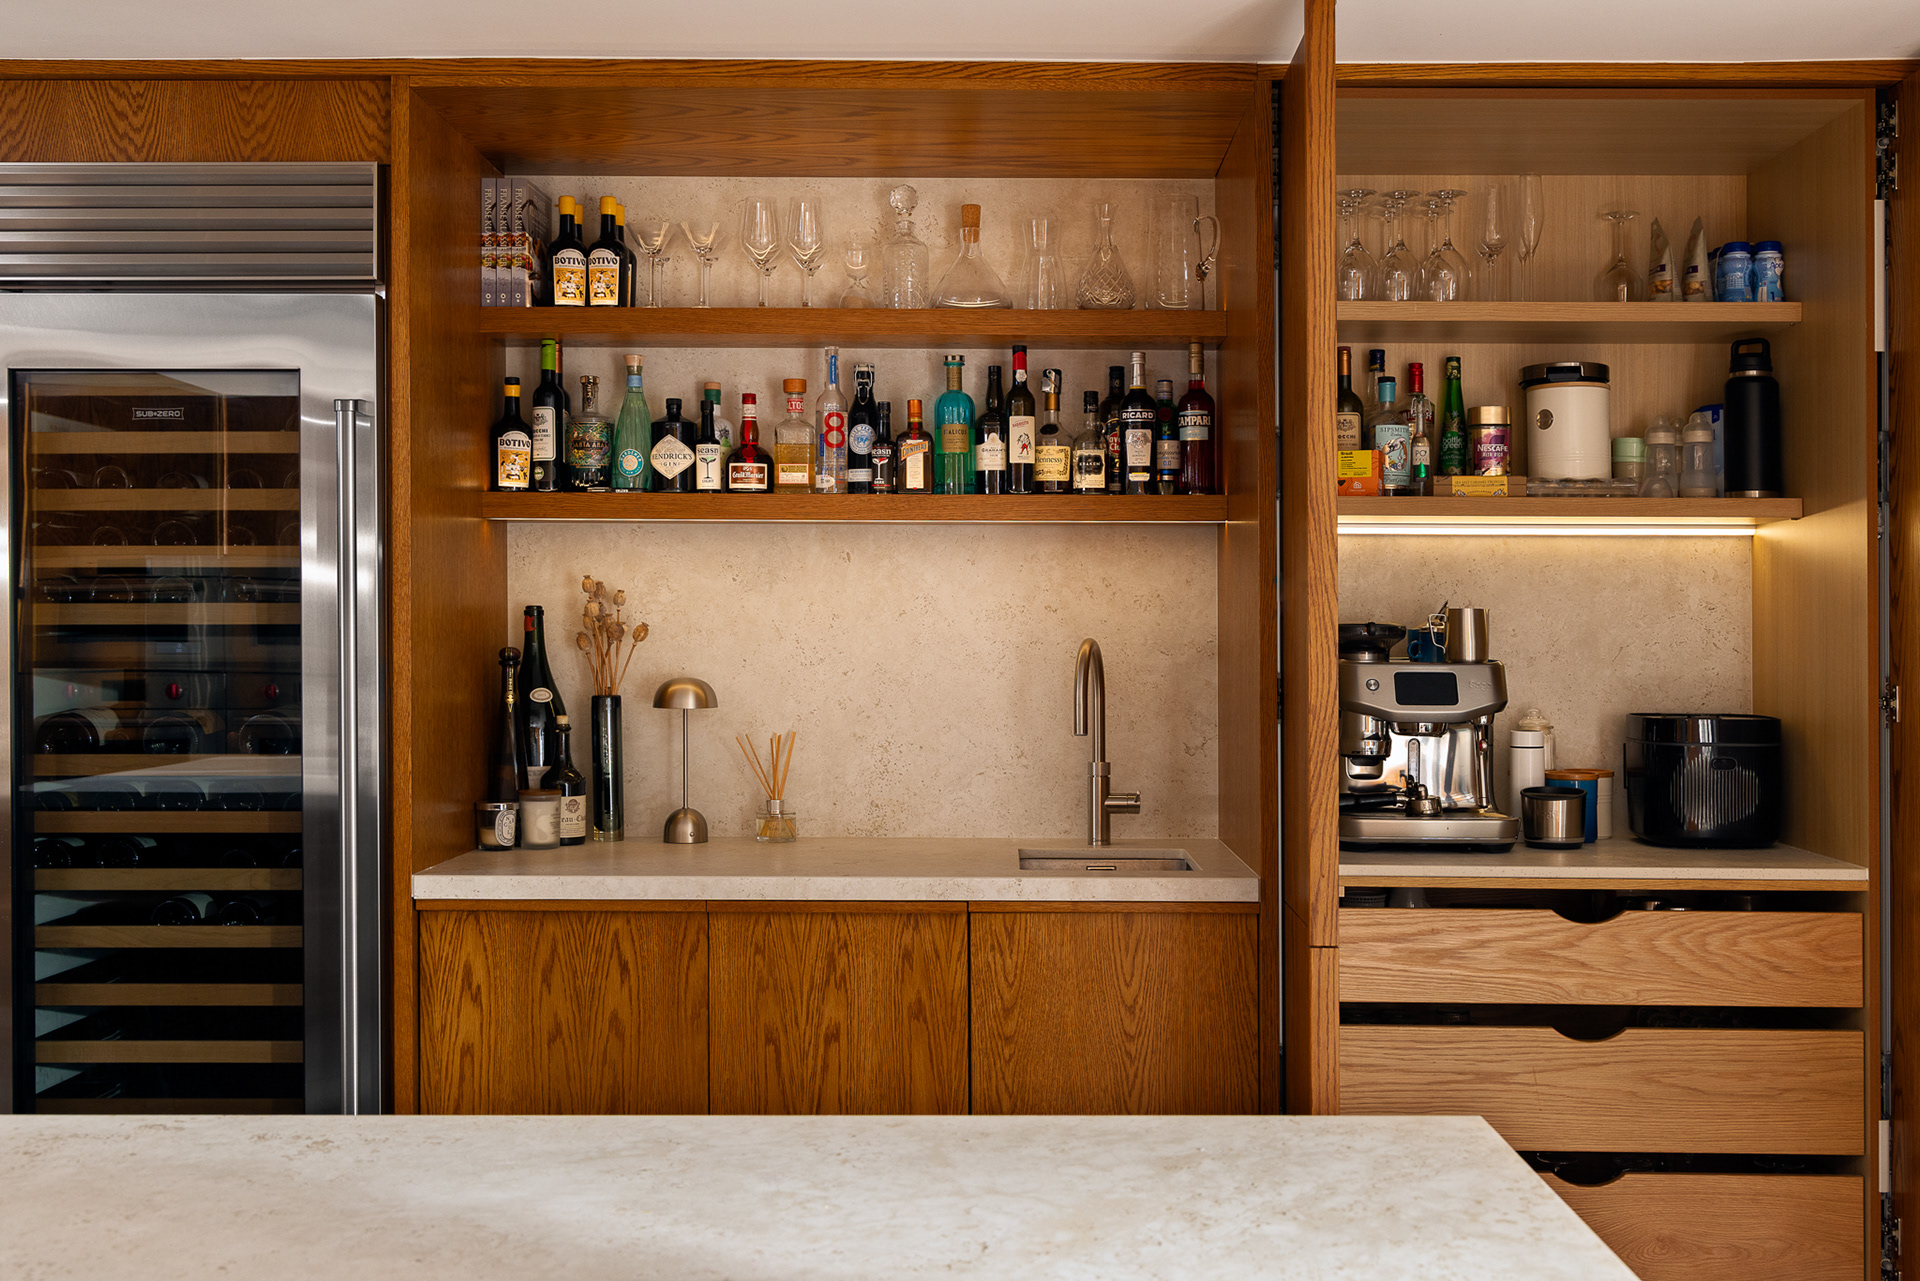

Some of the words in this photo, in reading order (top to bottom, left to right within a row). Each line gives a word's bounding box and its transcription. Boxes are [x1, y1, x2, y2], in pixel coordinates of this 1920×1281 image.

[484, 188, 492, 219] FRANSE
[499, 188, 508, 219] FRANSE
[514, 188, 523, 219] FRANSE
[554, 256, 587, 266] BOTIVO
[588, 256, 618, 266] BOTIVO
[788, 401, 804, 410] LTOS
[1121, 411, 1154, 420] RICARD
[824, 411, 846, 449] 8
[499, 438, 531, 449] BOTIVO
[902, 443, 927, 457] COINTREAU
